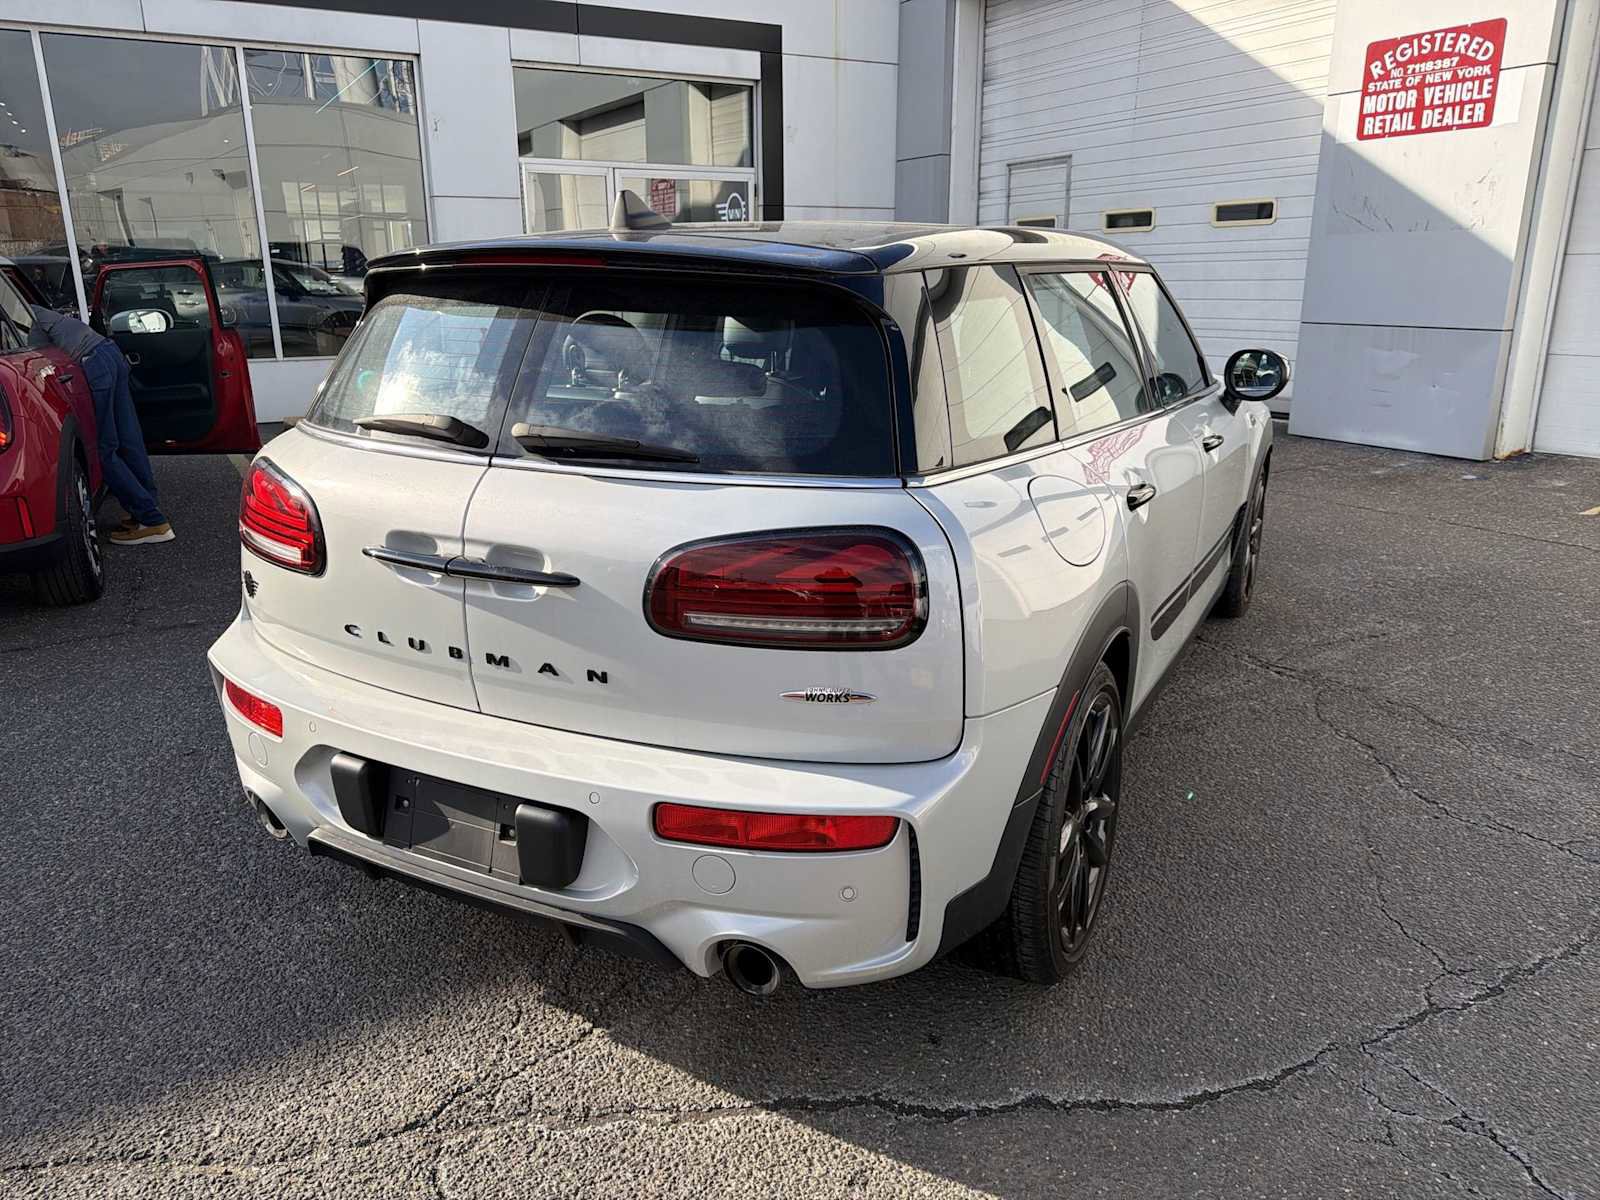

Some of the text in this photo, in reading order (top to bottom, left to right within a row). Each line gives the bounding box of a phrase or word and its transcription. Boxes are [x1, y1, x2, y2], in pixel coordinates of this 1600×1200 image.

[1369, 32, 1495, 80] REGISTERED
[1406, 57, 1459, 74] 7118387
[1367, 64, 1492, 93] STATE OF NEW YORK
[1363, 78, 1494, 115] MOTOR VEHICLE
[1363, 102, 1486, 136] RETAIL DEALER
[344, 623, 609, 684] CLUBMAN
[805, 693, 850, 703] WORKS
